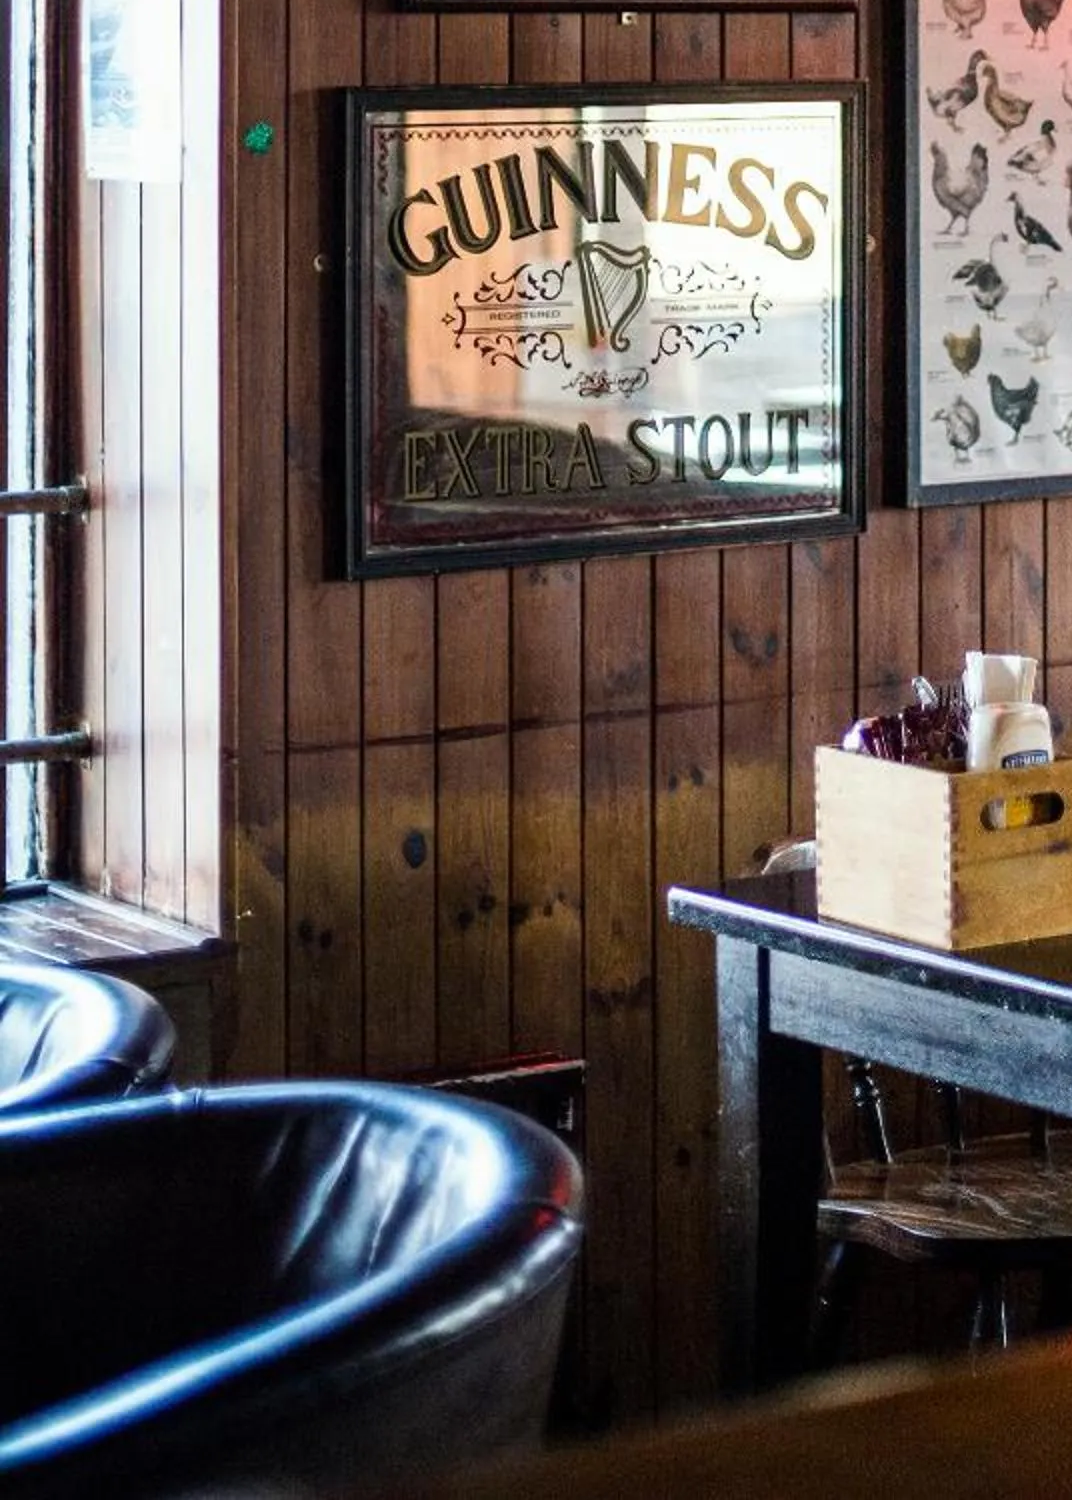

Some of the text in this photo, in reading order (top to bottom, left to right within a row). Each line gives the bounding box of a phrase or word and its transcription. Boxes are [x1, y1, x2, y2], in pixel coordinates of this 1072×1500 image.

[388, 139, 829, 277] GUINNESS
[402, 410, 809, 501] EXTRA STOUT
